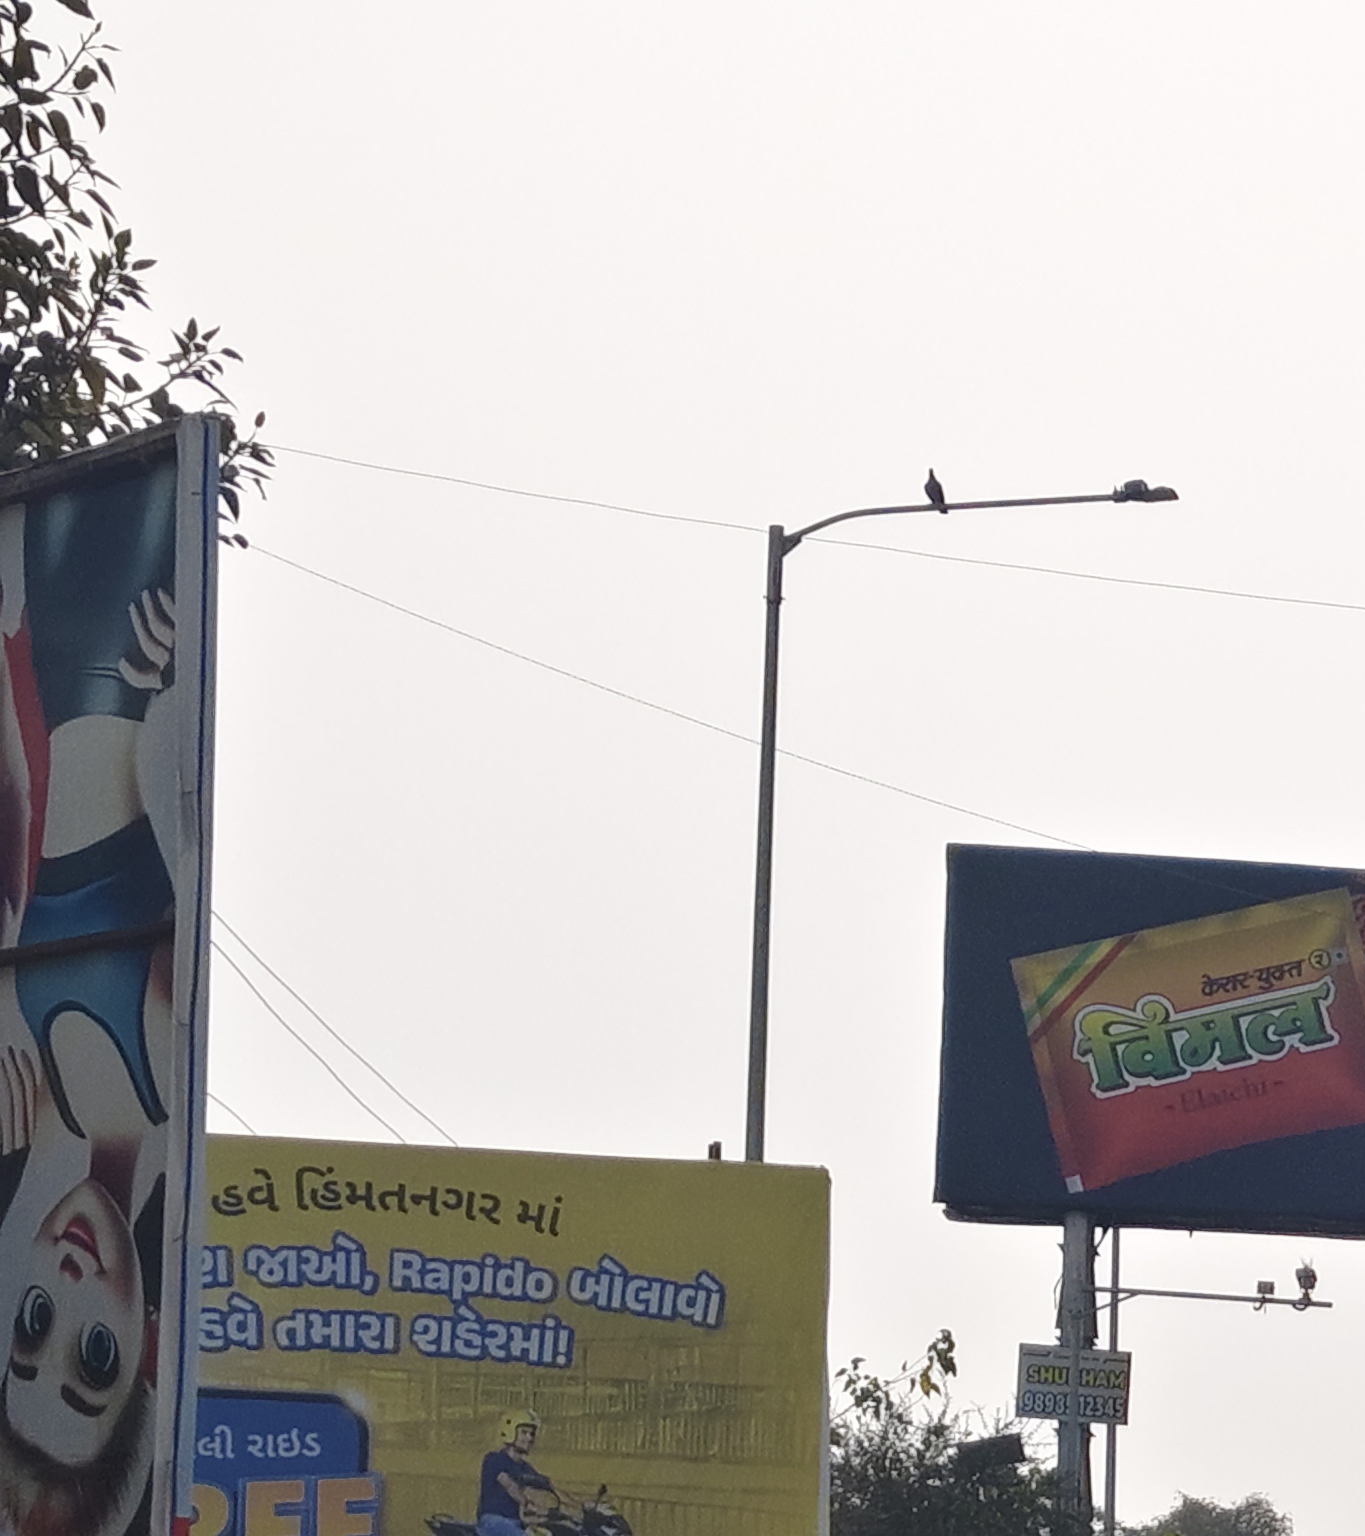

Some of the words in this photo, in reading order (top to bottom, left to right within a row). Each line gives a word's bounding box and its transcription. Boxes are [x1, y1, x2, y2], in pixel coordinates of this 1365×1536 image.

[1073, 976, 1340, 1099] विमल
[211, 1168, 279, 1216] હવે
[295, 1167, 504, 1225] હિંમતનગર
[516, 1194, 564, 1237] માં
[246, 1232, 377, 1295] જાઓ,
[391, 1252, 555, 1307] Rapido
[569, 1255, 724, 1328] બોલાવો
[274, 1311, 397, 1353] તમારા
[410, 1313, 571, 1367] શહેરમાં!
[1026, 1364, 1126, 1390] SHUHAM
